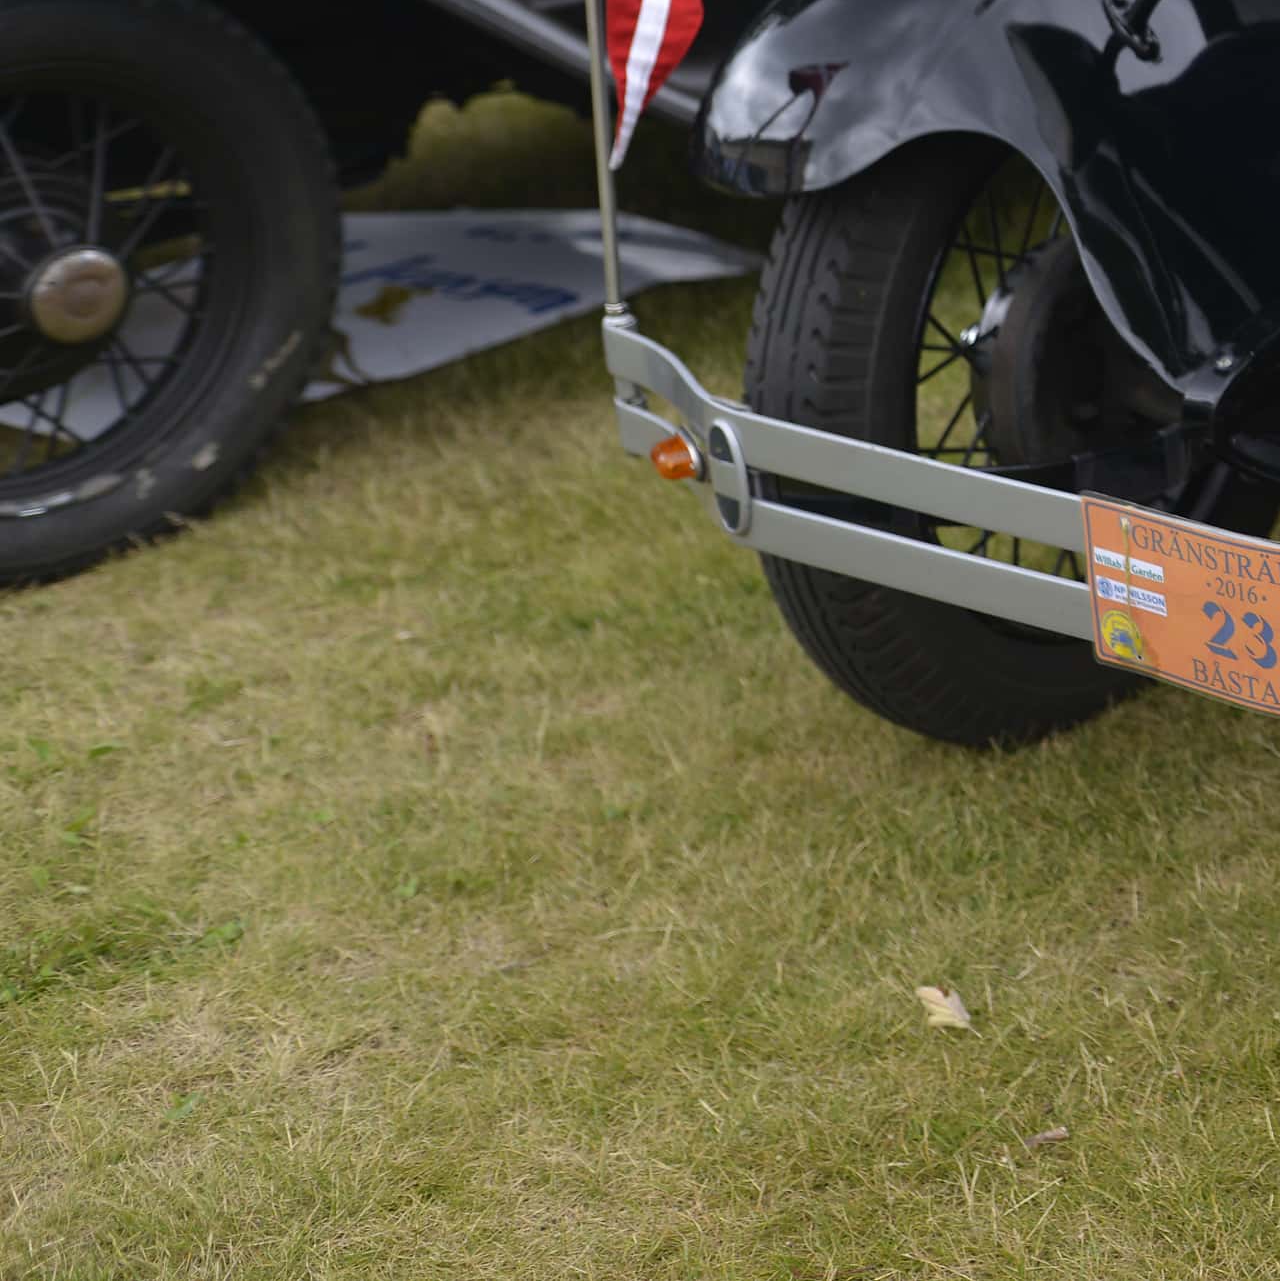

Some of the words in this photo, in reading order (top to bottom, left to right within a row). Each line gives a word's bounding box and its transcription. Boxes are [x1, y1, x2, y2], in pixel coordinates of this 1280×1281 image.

[1131, 565, 1163, 582] Garden
[1216, 577, 1258, 604] 2016
[1202, 601, 1277, 669] 23
